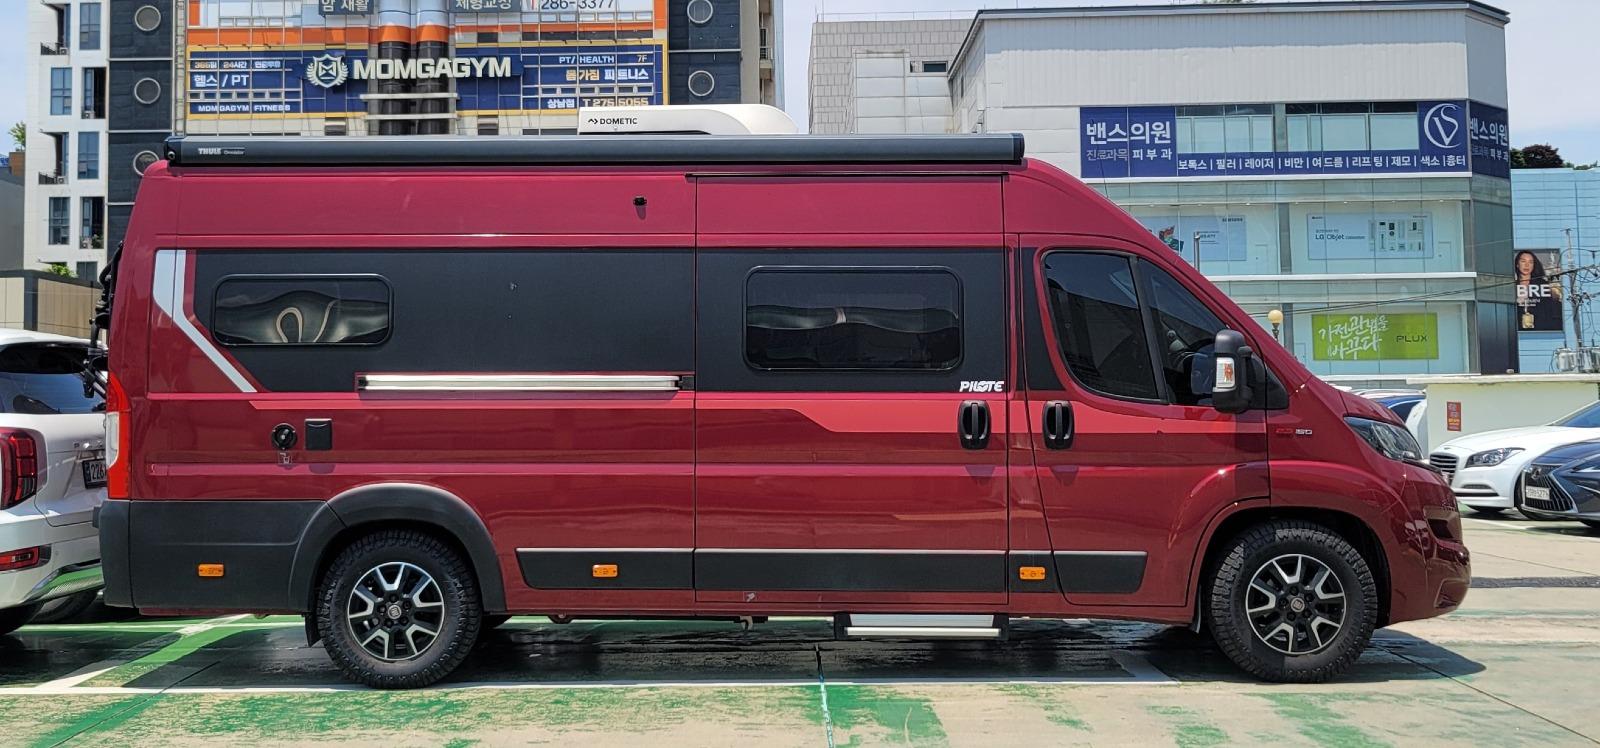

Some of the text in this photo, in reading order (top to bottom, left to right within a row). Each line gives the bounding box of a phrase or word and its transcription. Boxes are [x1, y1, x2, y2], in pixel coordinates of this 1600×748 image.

[223, 61, 247, 69] 24시간
[579, 55, 615, 64] HEALTH
[637, 55, 647, 63] 7F
[353, 56, 511, 80] MOMGAGYM
[566, 68, 649, 81] 몸가짐 피트니스
[193, 74, 218, 87] 헬스
[231, 75, 250, 86] PT
[198, 104, 249, 112] MOMGAGYM
[547, 98, 575, 109] 상남점
[582, 98, 591, 108] T
[592, 98, 615, 107] 275
[599, 117, 638, 125] DOMETIC
[1086, 120, 1171, 145] 밴스의원
[1470, 117, 1508, 147] 밴스의원
[197, 147, 222, 155] THULE
[1086, 148, 1128, 161] 진료과목
[1178, 154, 1466, 171] 보톡스 필러 레이저 비만 여드름 리프팅 제모 색소 흉터
[1395, 334, 1428, 344] PLUX
[1327, 334, 1383, 360] 바꾸다
[959, 380, 1005, 393] PILOTE
